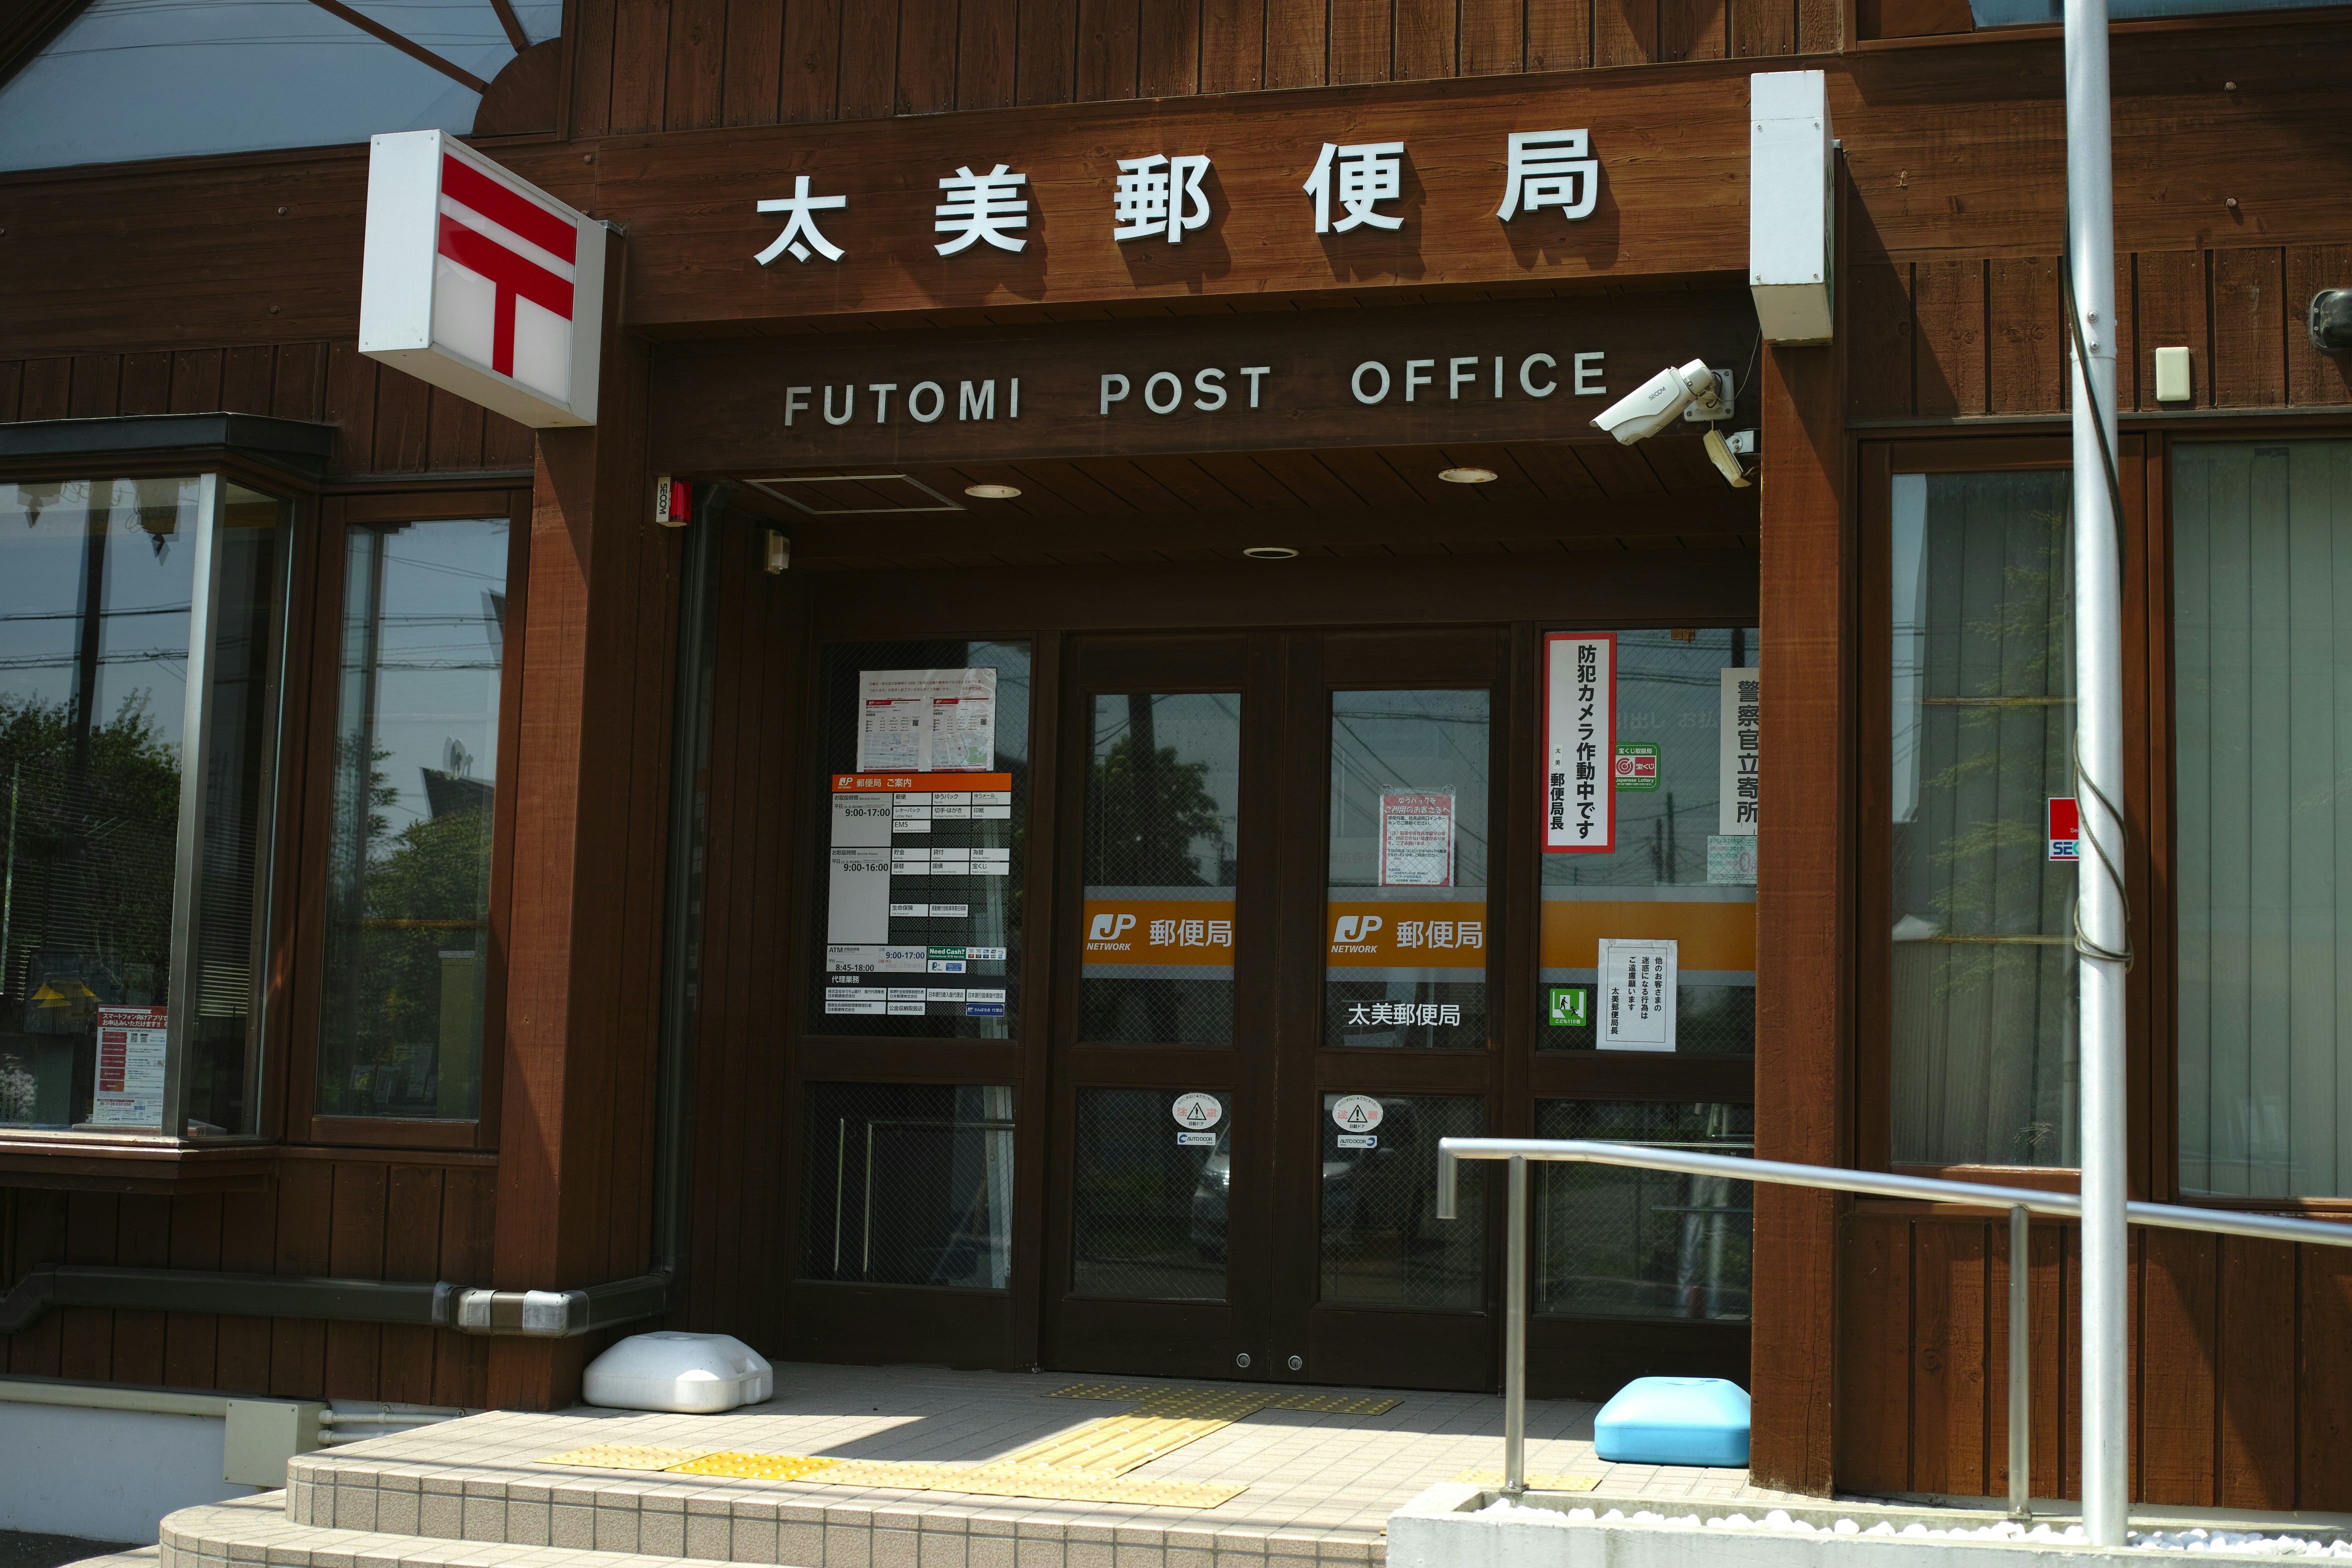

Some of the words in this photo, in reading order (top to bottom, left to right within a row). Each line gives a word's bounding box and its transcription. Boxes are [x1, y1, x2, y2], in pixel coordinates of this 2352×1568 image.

[753, 128, 1600, 267] 太美郵便局
[784, 377, 1020, 426] FUTOMI
[1099, 366, 1272, 416] POST
[1350, 350, 1608, 406] OFFICE
[1648, 386, 1666, 400] SECOM
[659, 482, 668, 514] SECOM
[1576, 644, 1597, 840] 防犯カメラ作動中です
[1736, 680, 1758, 824] 警察官立寄所
[1554, 748, 1561, 766] 太美
[838, 777, 853, 786] JP
[856, 778, 882, 788] 郵便局
[887, 778, 912, 788] ご案内
[1384, 806, 1450, 814] ご利用のお客さまへ
[1398, 796, 1436, 804] ゆうパックを
[1550, 773, 1565, 830] 郵便局長
[845, 808, 890, 816] 9:00-17:00
[844, 863, 888, 872] 9:00-16:00
[1089, 914, 1136, 940] JP
[1150, 919, 1232, 947] 郵便局
[1334, 916, 1382, 942] JP
[1396, 920, 1483, 948] 郵便局
[1330, 945, 1378, 953] NETWORK
[832, 976, 860, 984] 代理業務
[1628, 956, 1636, 1011] ご遠慮願います
[1640, 956, 1650, 1020] 迷惑になる行為は
[1654, 956, 1662, 1012] 他のお客さまの
[102, 1013, 168, 1021] スマートフォン向けアプリで
[1348, 1002, 1460, 1026] 太美郵便局
[1610, 987, 1620, 1034] 太美郵便局長
[102, 1020, 160, 1028] お申込みいただけます!!
[1177, 1107, 1188, 1116] 注
[1206, 1108, 1217, 1118] 意
[1337, 1110, 1348, 1120] 注
[1368, 1110, 1378, 1120] 意
